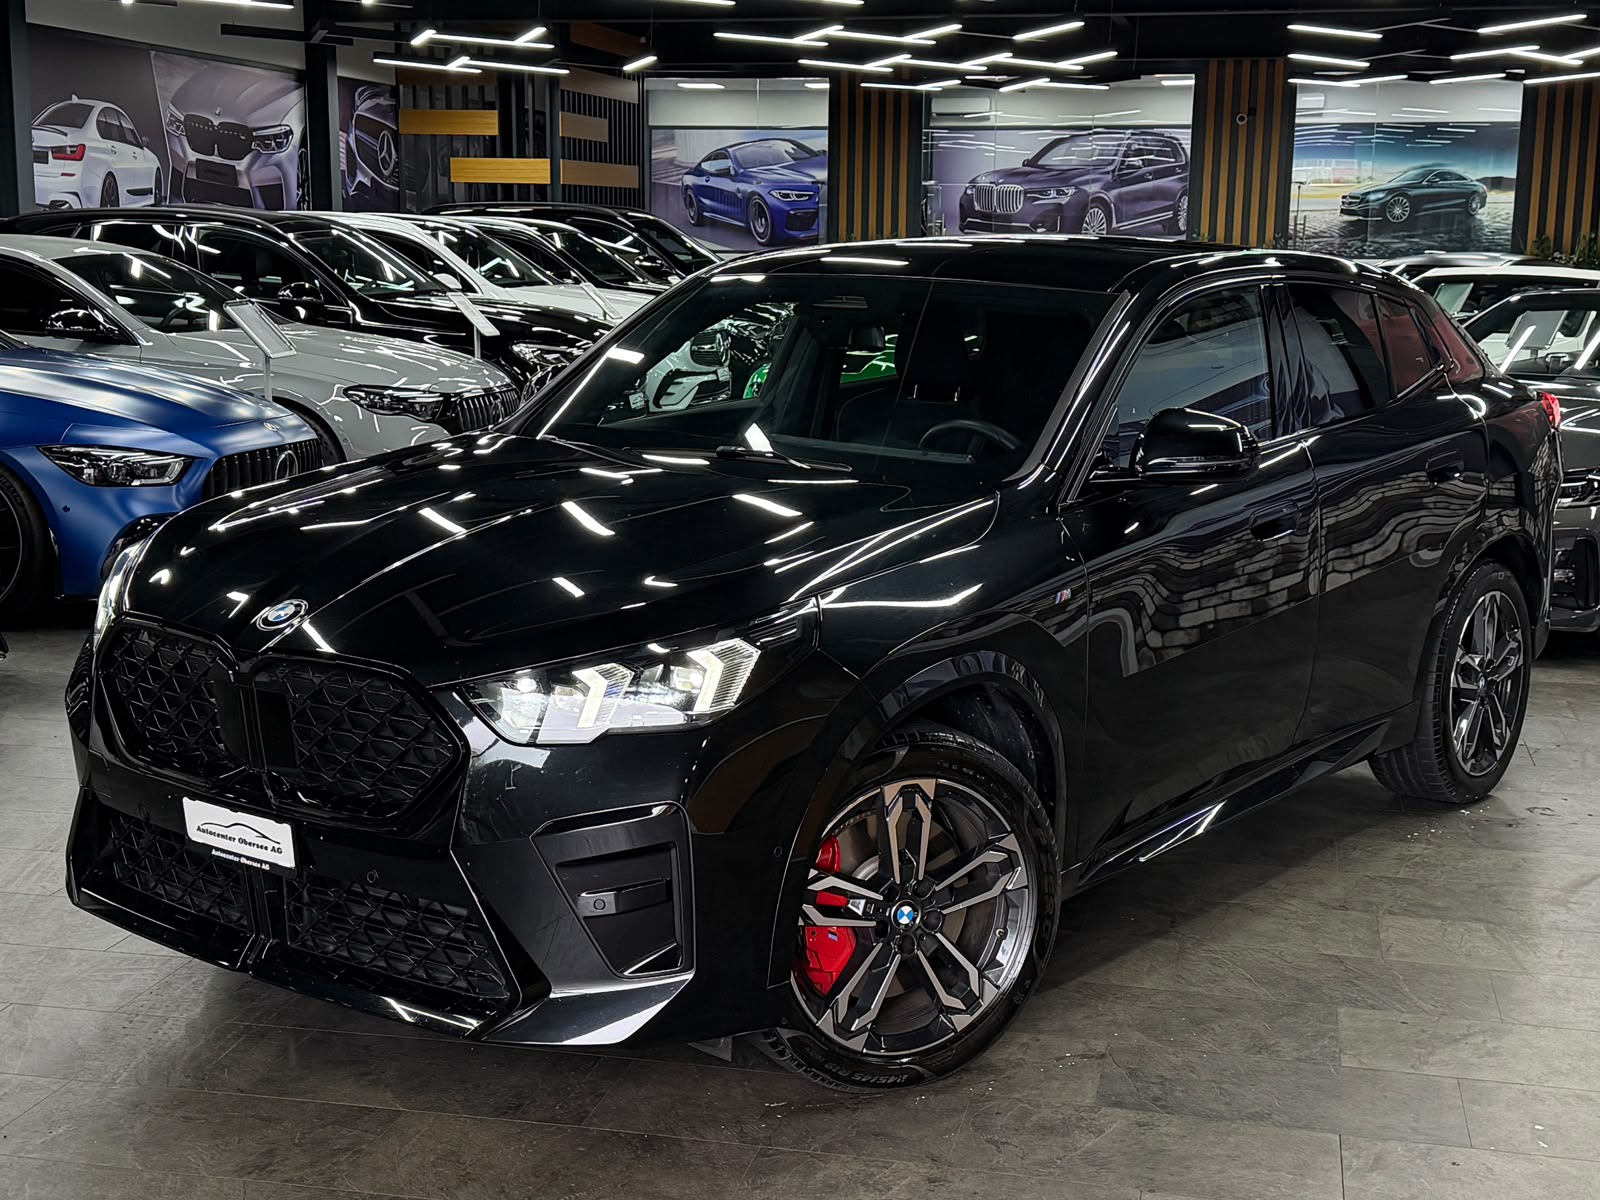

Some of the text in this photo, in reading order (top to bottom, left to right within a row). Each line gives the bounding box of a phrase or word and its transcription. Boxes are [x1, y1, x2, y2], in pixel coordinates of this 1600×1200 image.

[196, 825, 283, 855] Autocenter Obersee AG
